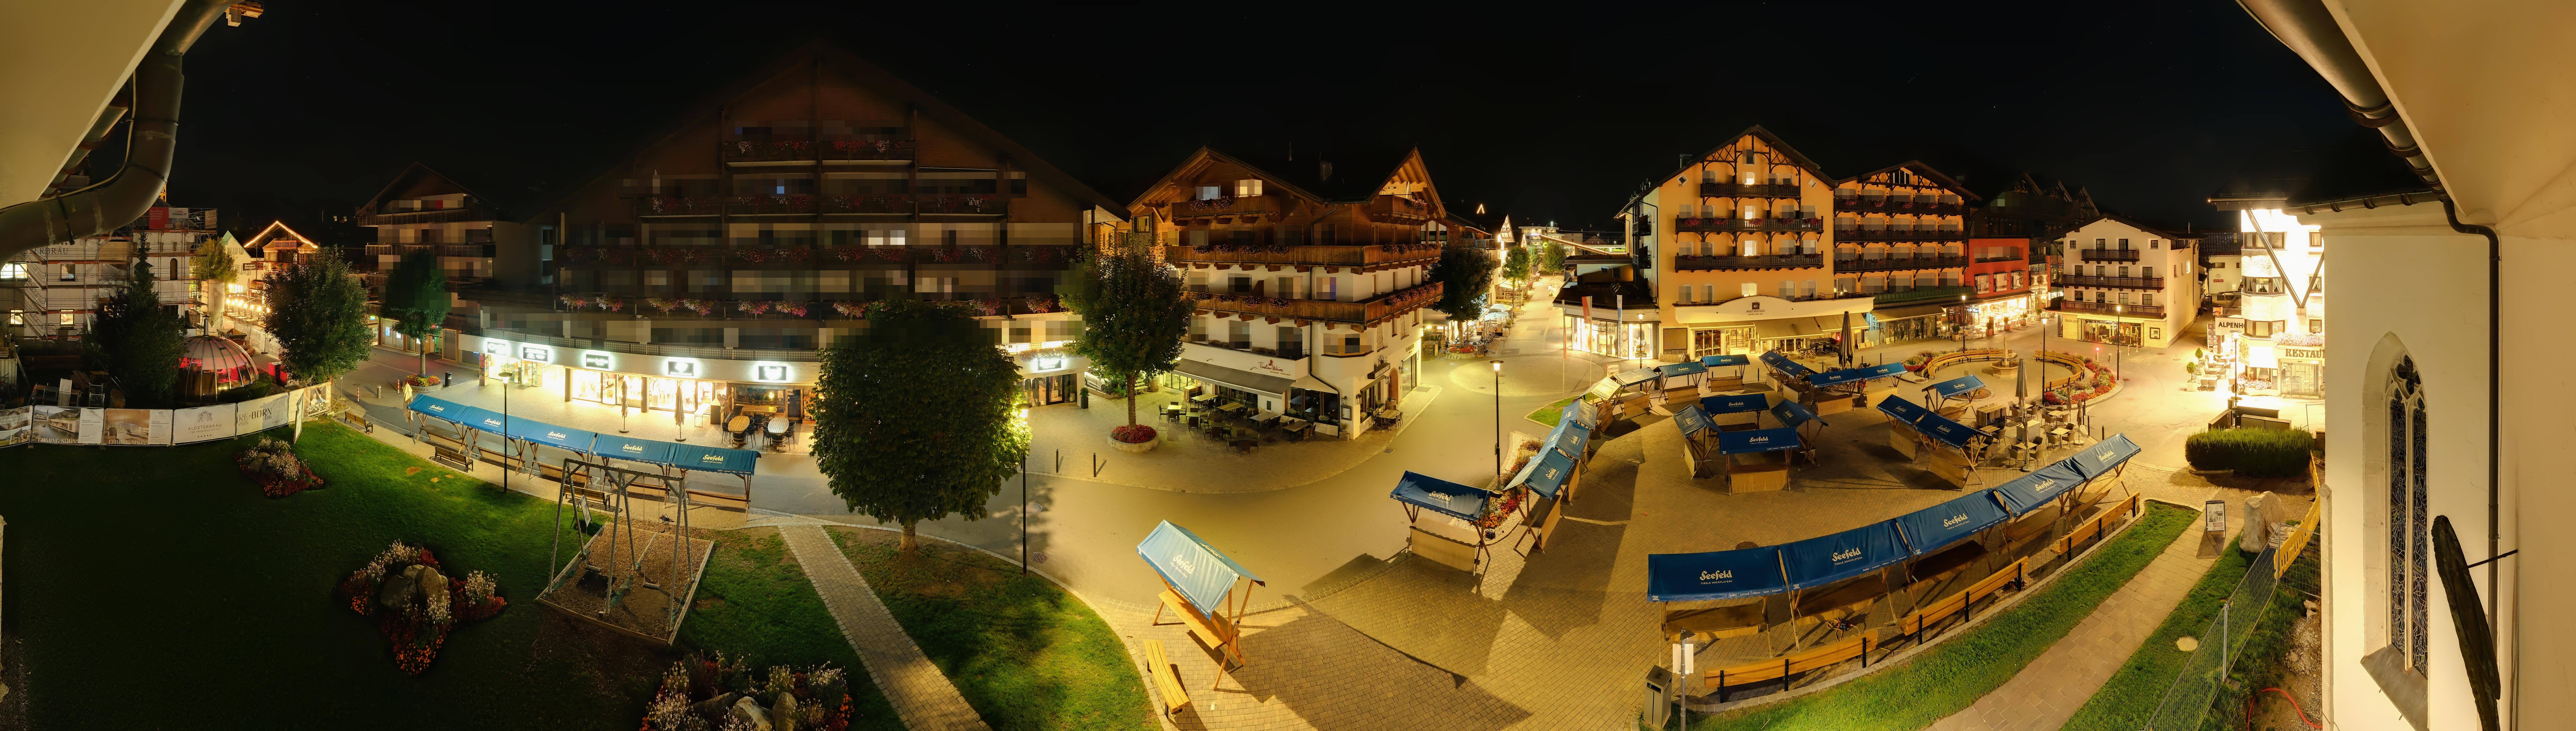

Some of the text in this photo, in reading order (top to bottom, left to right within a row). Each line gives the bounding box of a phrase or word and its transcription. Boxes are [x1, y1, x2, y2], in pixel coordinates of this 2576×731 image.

[1405, 343, 1414, 352] SAILER
[1375, 365, 1389, 378] RESTAURANT
[2099, 450, 2114, 461] Seefeld
[1545, 468, 1556, 479] Seefeld
[2035, 478, 2055, 491] Seefeld
[1429, 491, 1452, 501] Seefeld
[1944, 513, 1968, 527] Seefeld
[1832, 547, 1861, 562] Seefeld
[1173, 554, 1196, 574] Seefeld
[1175, 566, 1188, 578] HOCHPLATEAU
[1699, 570, 1732, 581] Seefeld
